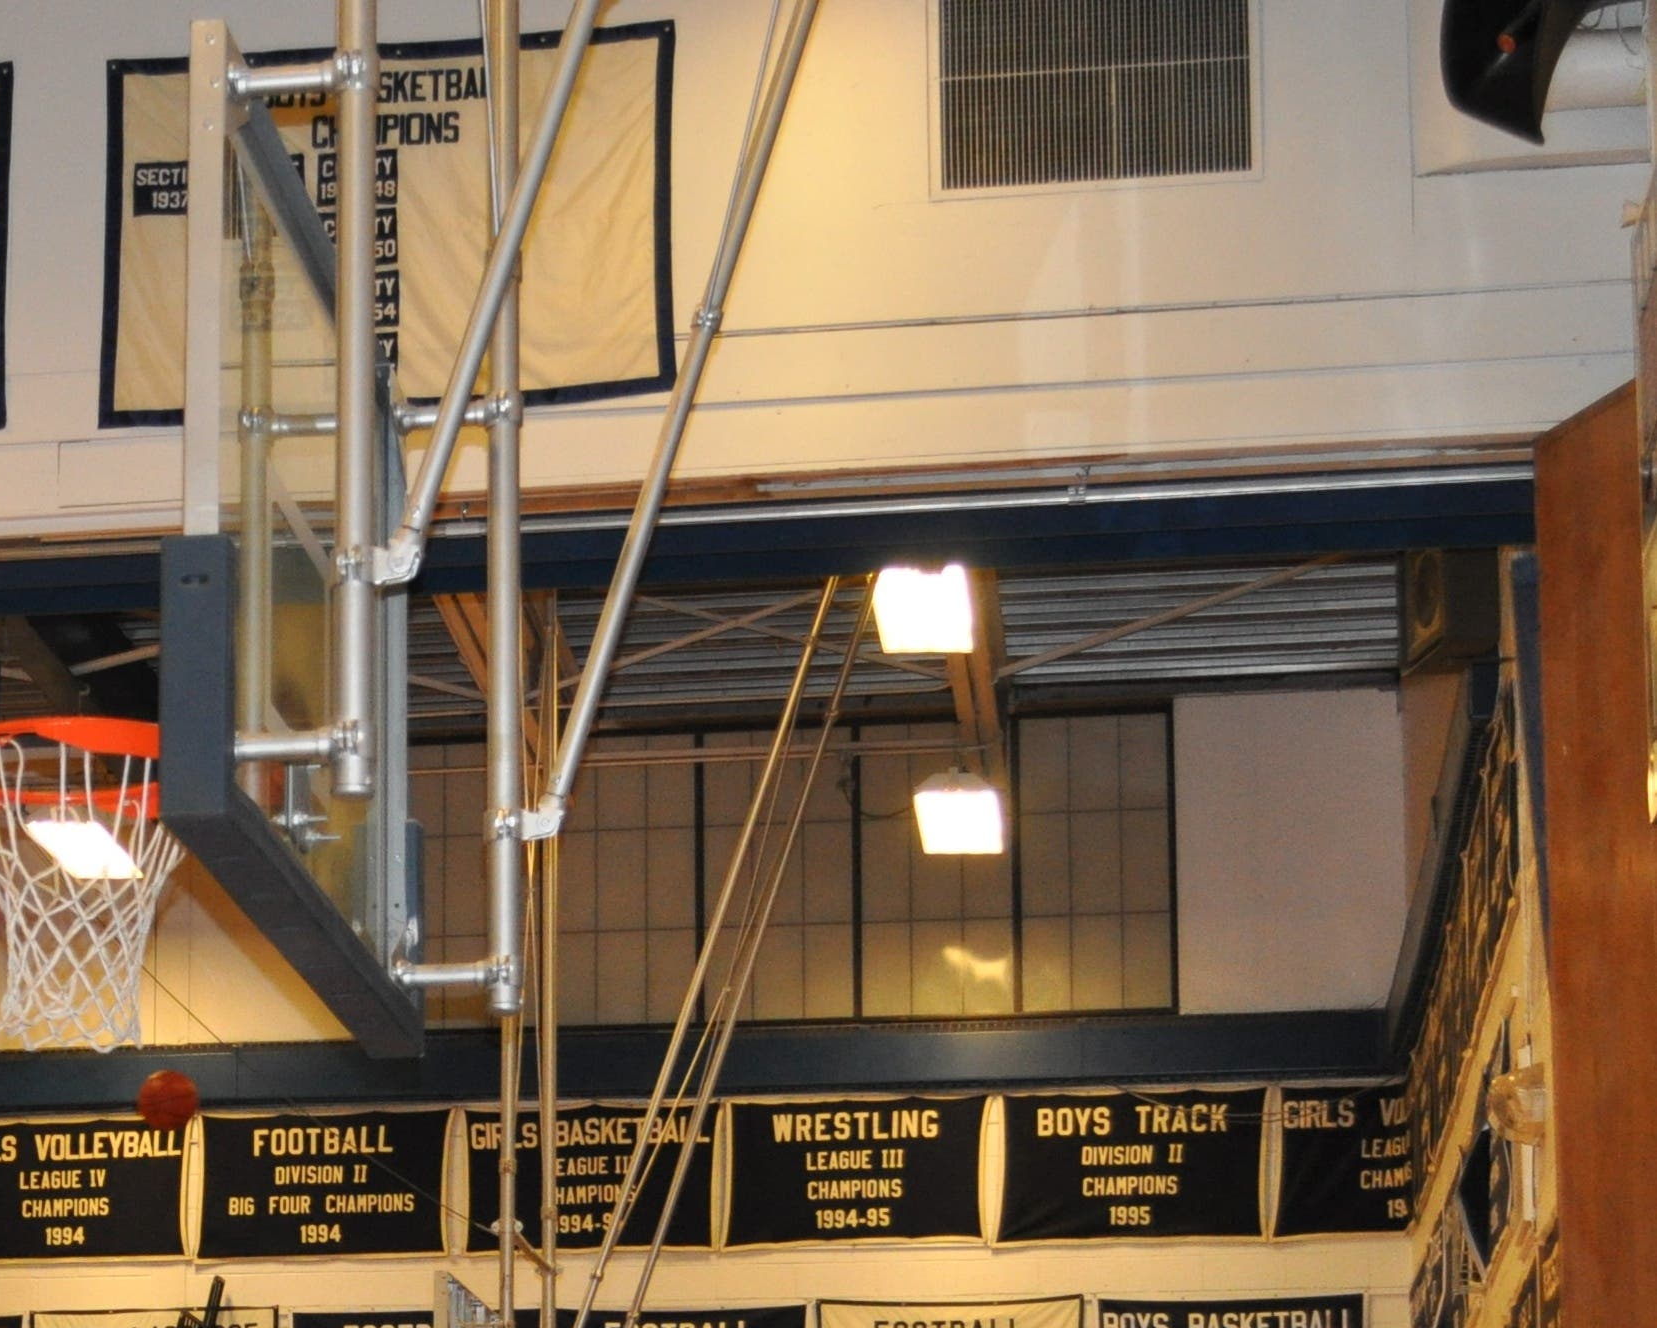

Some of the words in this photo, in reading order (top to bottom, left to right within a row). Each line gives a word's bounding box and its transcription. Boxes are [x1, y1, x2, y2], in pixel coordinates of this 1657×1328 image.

[1037, 1106, 1111, 1137] BOYS
[1135, 1103, 1228, 1133] TRACK
[1283, 1099, 1355, 1128] GIRLS
[772, 1109, 940, 1143] WRESTLING
[35, 1129, 181, 1161] VOLLEYBALL
[253, 1125, 393, 1157] FOOTBALL
[806, 1151, 872, 1171] LEAGUE
[1081, 1144, 1153, 1166] DIVISION
[19, 1172, 81, 1190] LEAGUE
[275, 1166, 344, 1185] DIVISION
[1082, 1175, 1178, 1196] CHAMPIONS
[807, 1179, 903, 1200] CHAMPIONS
[21, 1198, 110, 1218] CHAMPIONS
[228, 1198, 255, 1216] BIG
[269, 1196, 312, 1215] FOUR
[325, 1194, 415, 1214] CHAMPIONS
[1109, 1206, 1151, 1225] 1995
[815, 1208, 890, 1229] 1994-95
[45, 1227, 85, 1246] 1994
[300, 1225, 342, 1243] 1994
